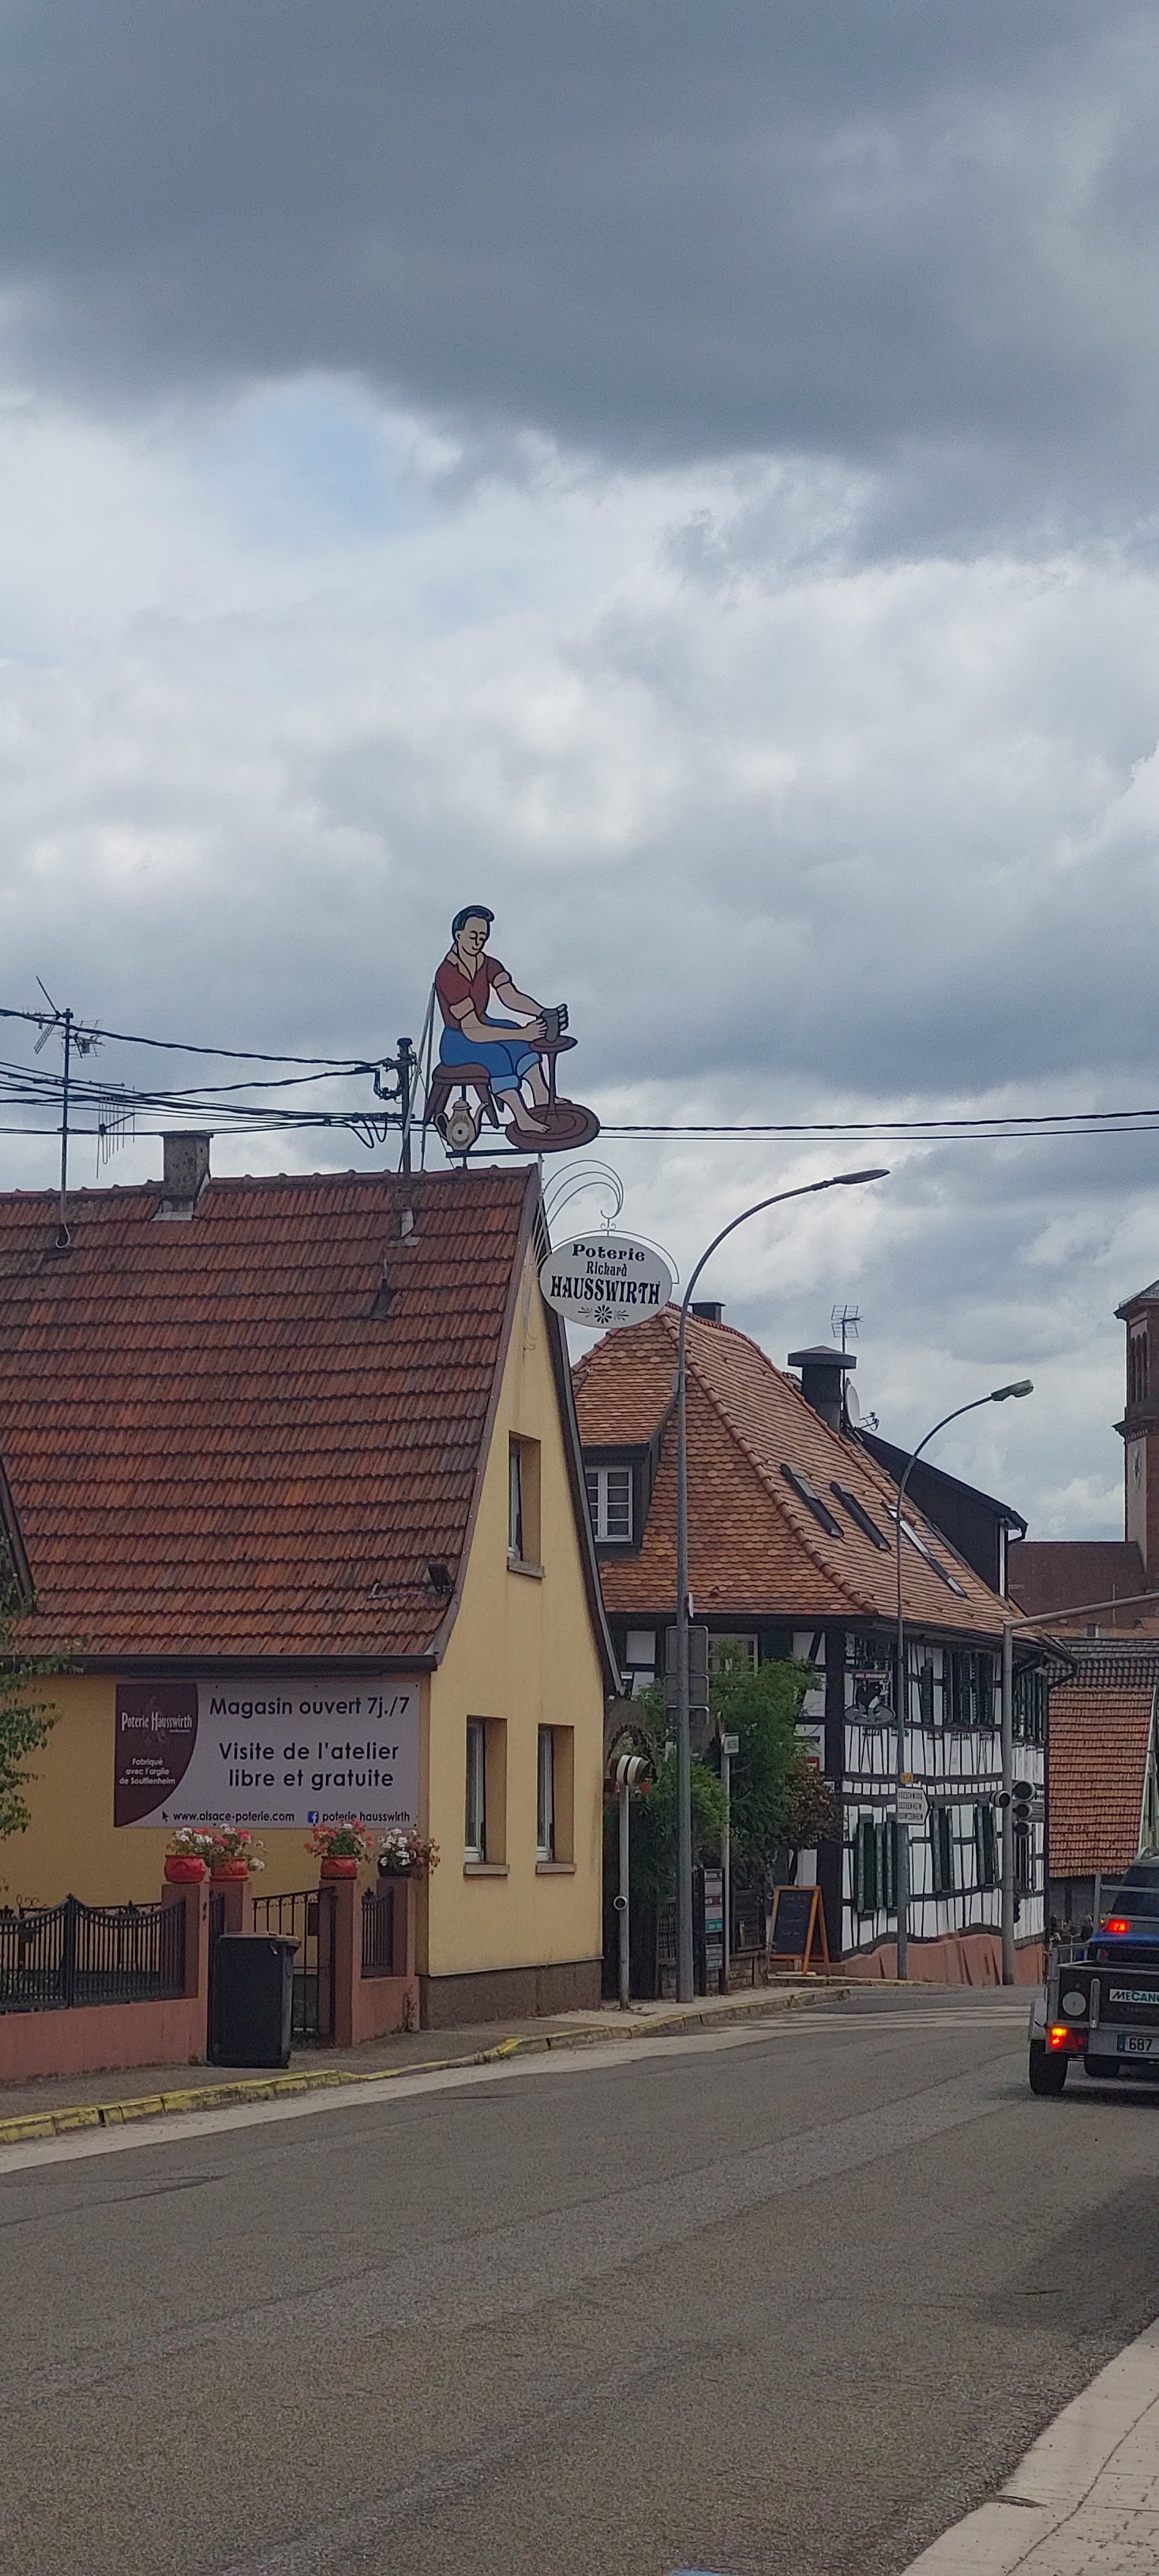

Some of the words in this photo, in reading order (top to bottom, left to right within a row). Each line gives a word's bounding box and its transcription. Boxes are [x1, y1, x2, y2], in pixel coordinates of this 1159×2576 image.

[572, 1244, 646, 1262] Poterie
[586, 1260, 628, 1277] Richard
[549, 1275, 661, 1305] HAUSSWIRTH
[209, 1697, 293, 1719] Magasin
[299, 1697, 362, 1715] ouvert
[367, 1697, 410, 1718] 7j./7
[122, 1712, 149, 1732] Poterie
[151, 1711, 193, 1732] Hausswirth
[219, 1742, 275, 1760] Visite
[283, 1742, 310, 1760] de
[317, 1742, 399, 1760] l'atelier
[132, 1757, 163, 1767] Fabriqué
[229, 1769, 275, 1787] libre
[283, 1769, 303, 1787] et
[311, 1769, 394, 1791] gratuite
[173, 1810, 295, 1822] www.alsace-poterie.com
[322, 1811, 357, 1823] poterie
[359, 1811, 410, 1822] hausswirth
